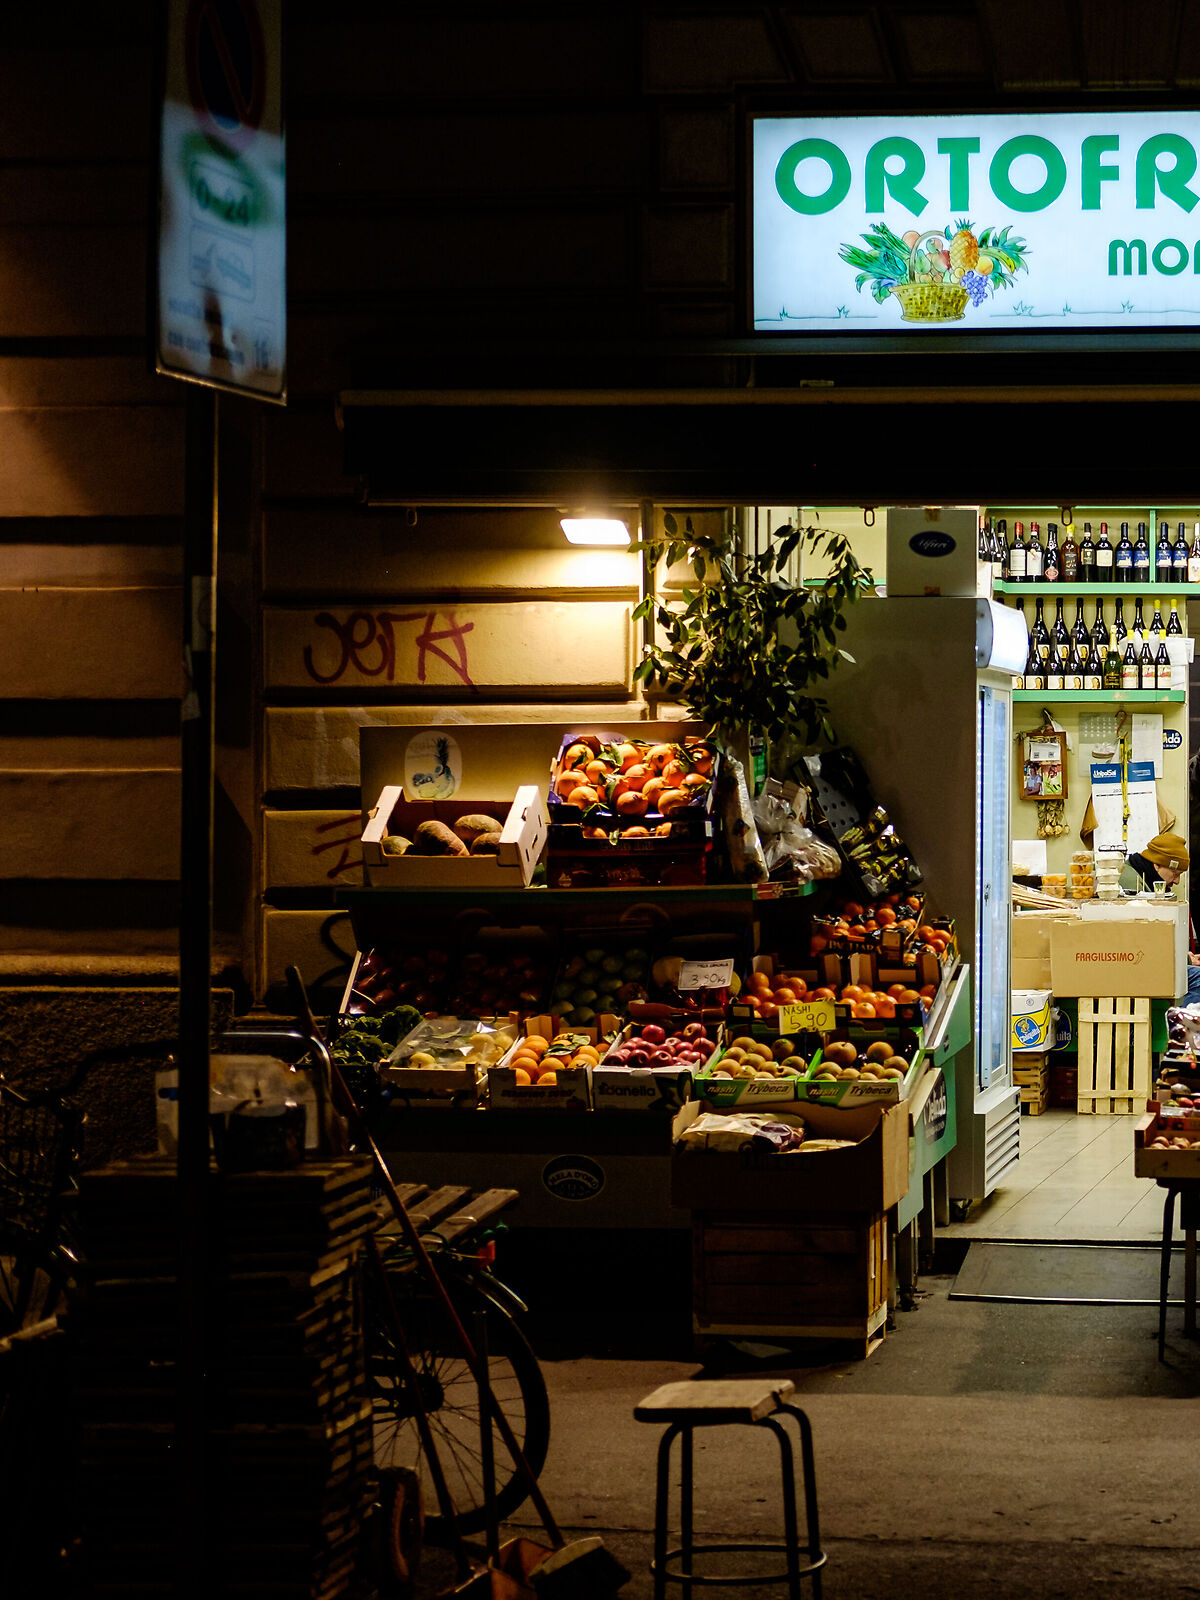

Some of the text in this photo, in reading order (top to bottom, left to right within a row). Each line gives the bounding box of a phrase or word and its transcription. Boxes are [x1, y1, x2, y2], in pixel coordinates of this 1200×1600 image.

[1075, 952, 1135, 962] FRAGILISSIMO
[783, 1005, 811, 1016] NASHI
[1056, 1031, 1072, 1041] uita
[747, 1084, 789, 1095] Trybeca
[850, 1085, 892, 1097] Trybeca
